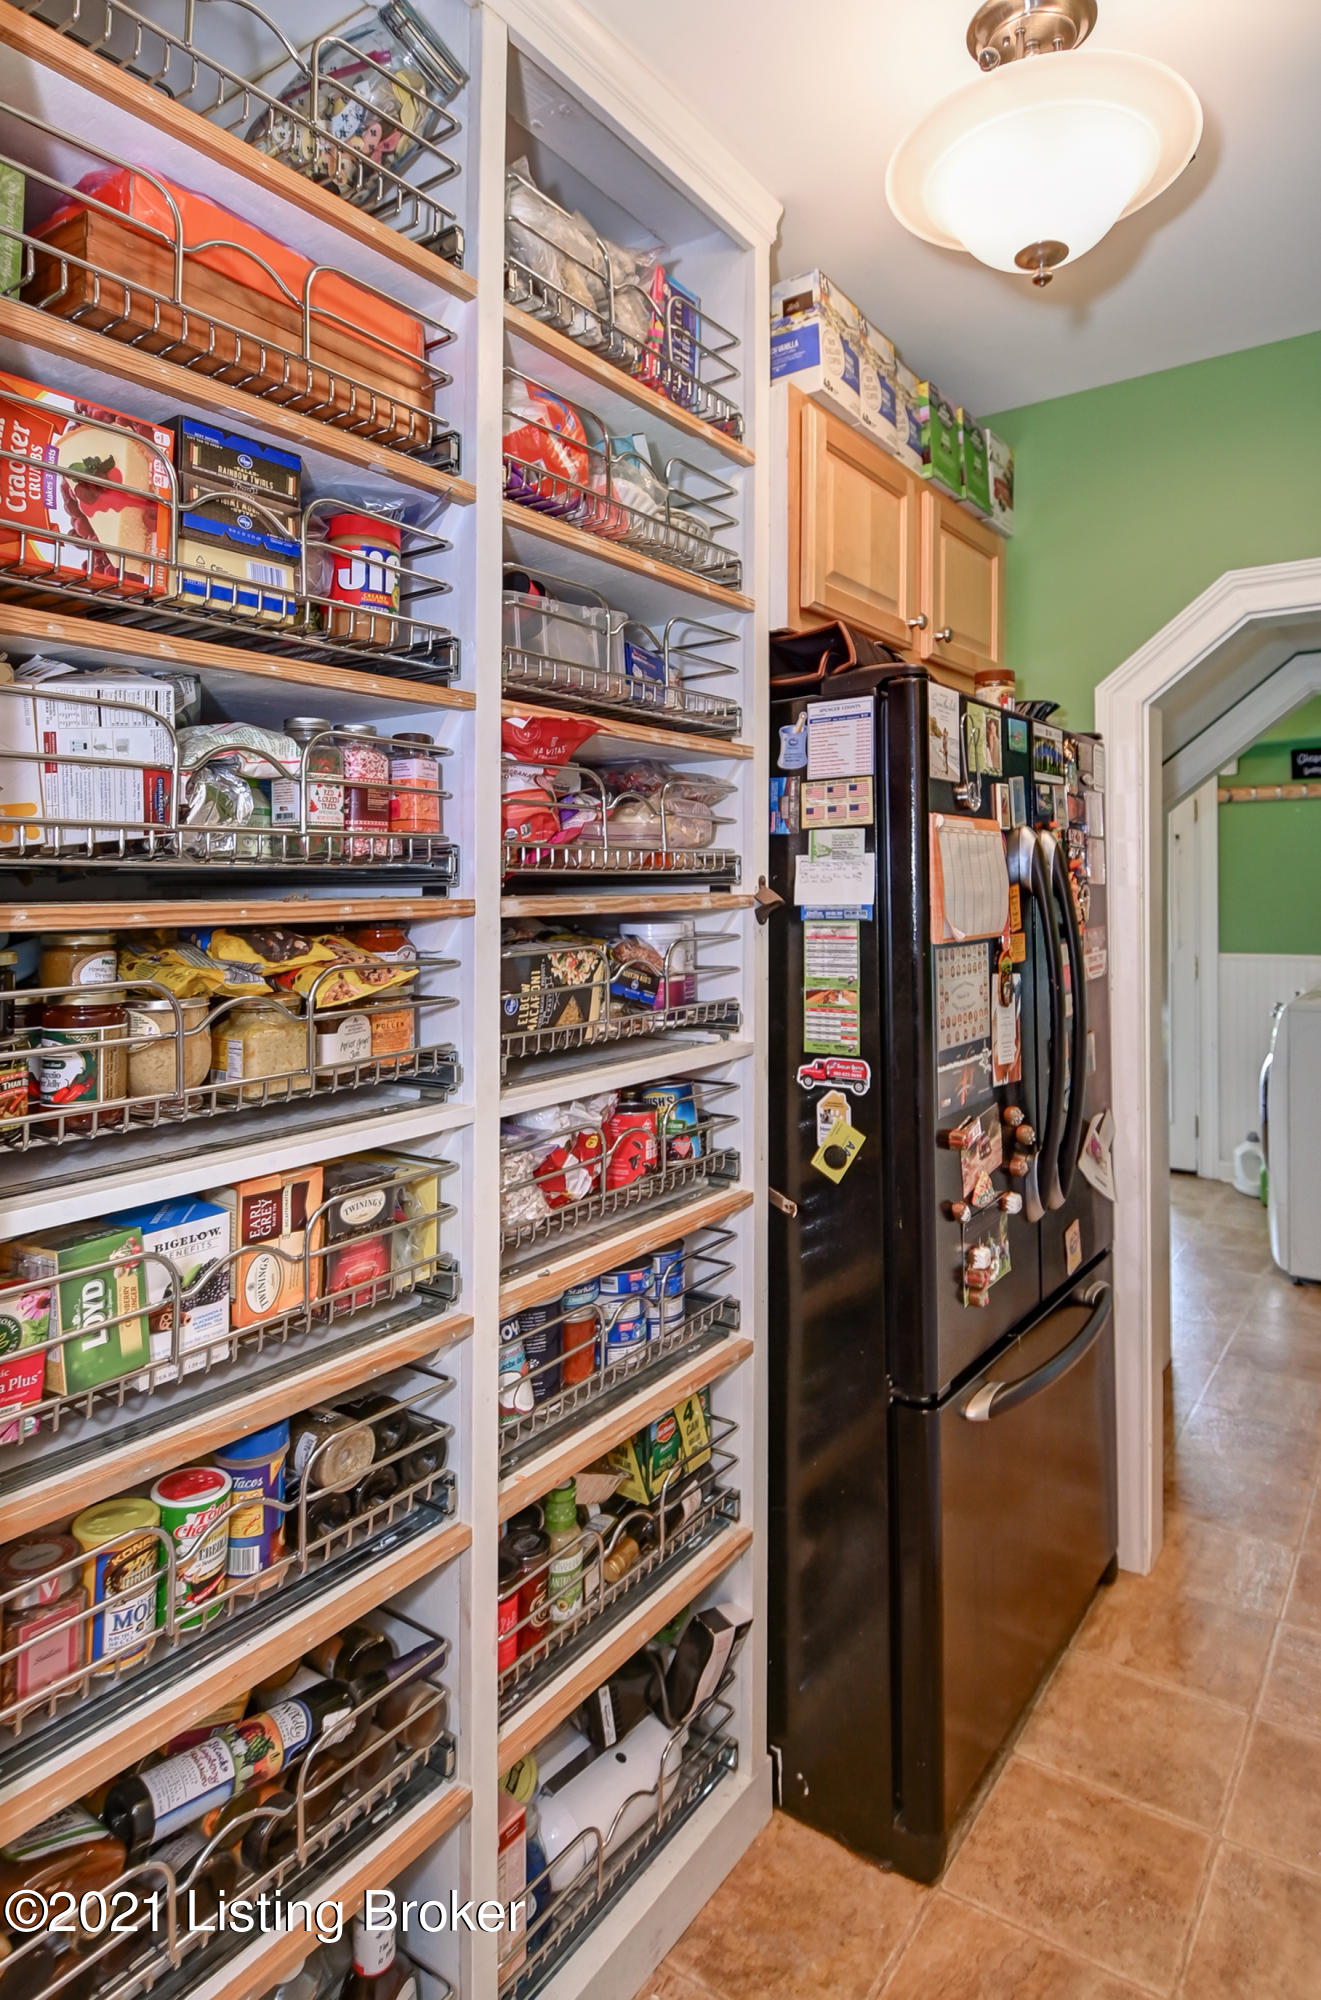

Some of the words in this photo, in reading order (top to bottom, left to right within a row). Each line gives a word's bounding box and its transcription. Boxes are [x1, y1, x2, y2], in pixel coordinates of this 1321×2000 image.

[218, 465, 248, 481] RAINBOW
[250, 475, 274, 489] TWIRLS
[46, 482, 55, 507] Makes
[338, 549, 400, 594] Jif
[518, 982, 530, 1026] ELBOW
[527, 969, 542, 1032] MACARONI
[249, 1200, 262, 1239] EARL
[260, 1198, 273, 1237] GREY
[344, 1197, 384, 1217] TWININGS
[154, 1226, 219, 1253] BIGELOW
[163, 1240, 213, 1260] ENEFITS
[257, 1256, 271, 1309] TWININGS
[124, 1285, 132, 1328] CRNBERRY
[9, 1373, 39, 1392] Plus
[684, 1400, 694, 1419] 4
[232, 1474, 264, 1489] Tacos
